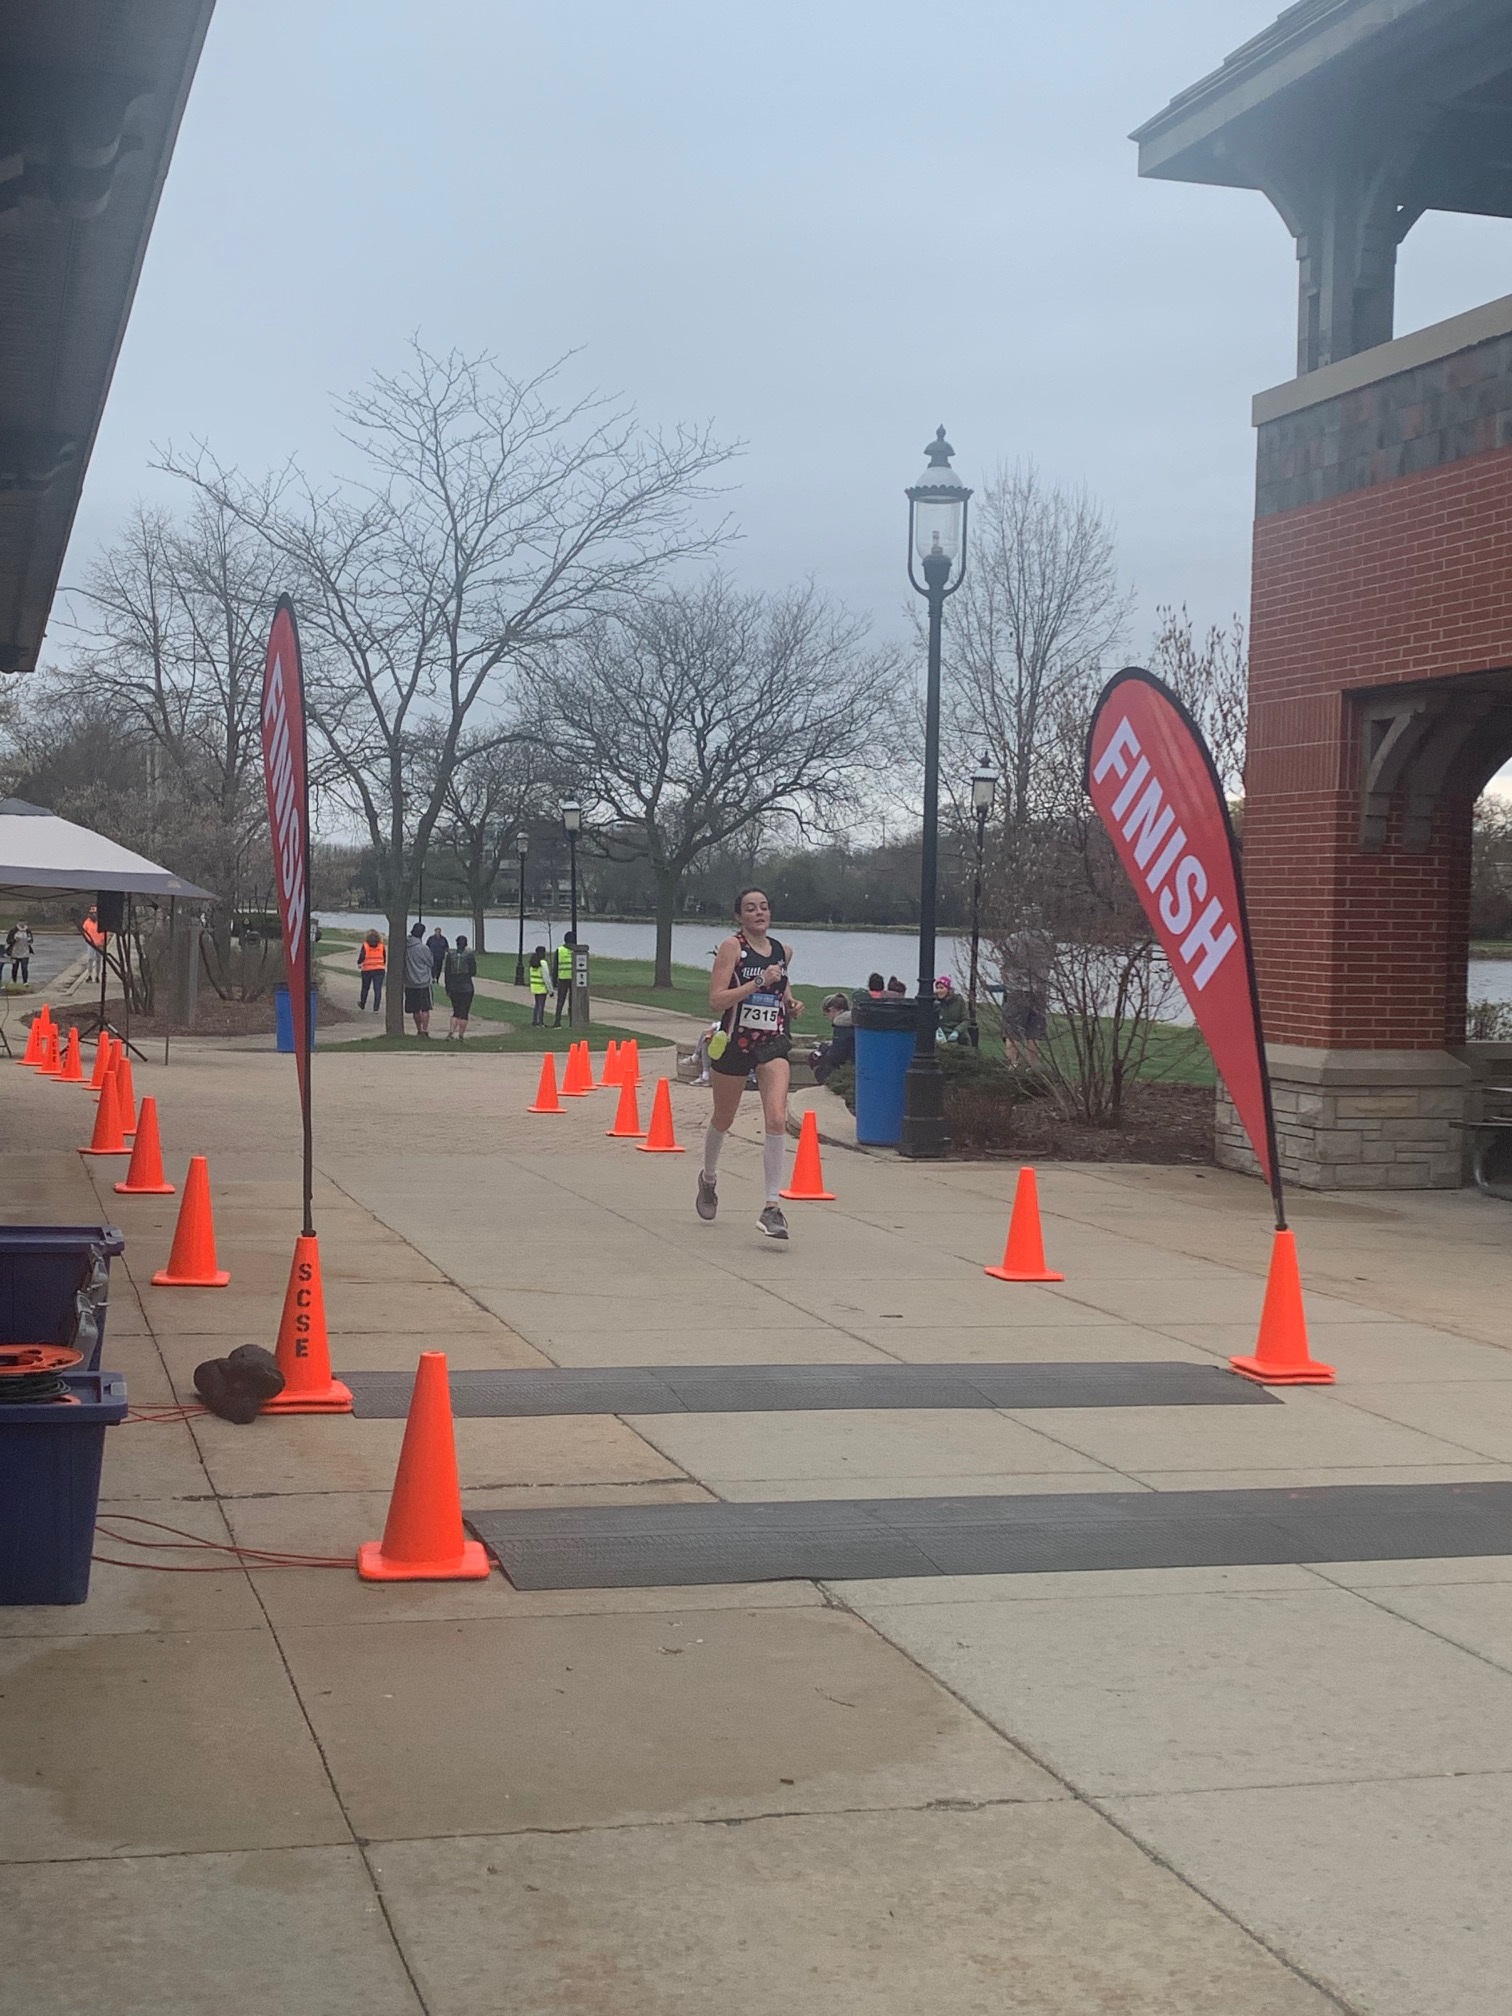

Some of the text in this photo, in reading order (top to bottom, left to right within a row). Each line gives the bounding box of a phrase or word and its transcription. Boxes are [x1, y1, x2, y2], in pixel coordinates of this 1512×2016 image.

[264, 650, 306, 965] FINISH
[1092, 715, 1238, 992] FINISH
[743, 1007, 778, 1022] 7315
[295, 1263, 312, 1359] SCSE
